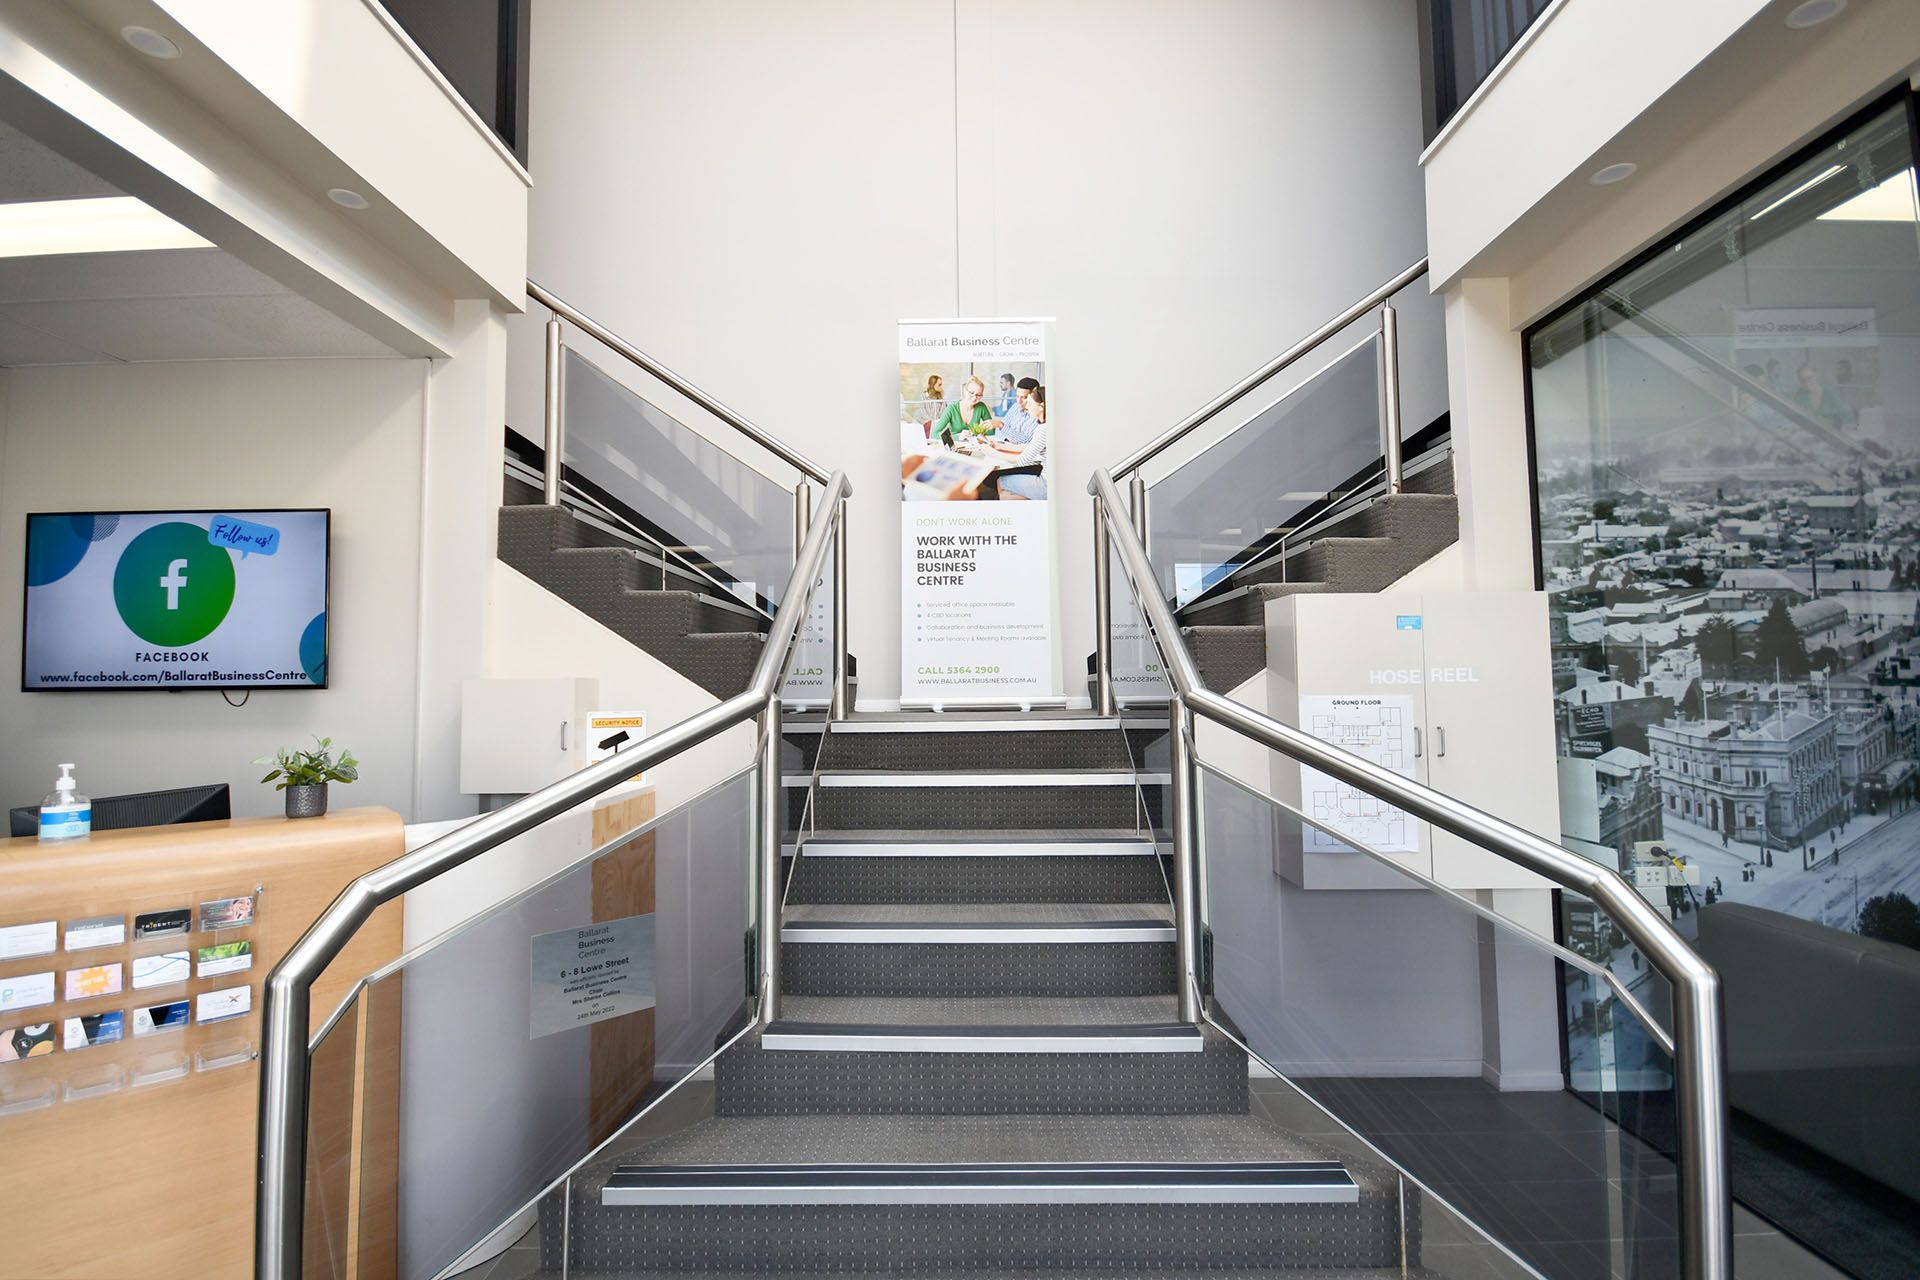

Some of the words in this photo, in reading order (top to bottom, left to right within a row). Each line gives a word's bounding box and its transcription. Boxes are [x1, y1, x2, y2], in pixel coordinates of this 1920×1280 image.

[906, 337, 948, 347] Ballarat
[951, 337, 1000, 346] Business
[1002, 335, 1039, 346] Centre
[916, 518, 945, 527] DON'T
[948, 518, 978, 526] WORK
[981, 517, 1012, 526] ALONE
[214, 524, 254, 544] Follow
[254, 533, 273, 548] us!
[917, 536, 955, 546] WORK
[958, 535, 991, 545] WITH
[994, 535, 1017, 545] THE
[917, 549, 977, 559] BALLARAT
[917, 562, 976, 572] BUSINESS
[917, 575, 964, 586] CENTRE
[135, 651, 209, 662] FACEBOOK
[40, 669, 307, 684] www.facebook.com/BallaratBusinessCentre
[917, 666, 944, 675] CALL
[947, 666, 972, 674] 5364
[975, 666, 1000, 674] 2900
[1369, 669, 1421, 685] HOSE
[1430, 667, 1480, 683] REEL
[917, 677, 1037, 685] WWW.BALLARATBUSINESS.COM.AU
[578, 926, 609, 939] Ballarat
[578, 936, 615, 949] Business
[578, 947, 606, 959] Centre
[560, 970, 566, 978] 6
[581, 964, 603, 974] Lowe
[605, 957, 629, 968] Street
[563, 984, 585, 994] Ballarat
[585, 979, 609, 989] Business
